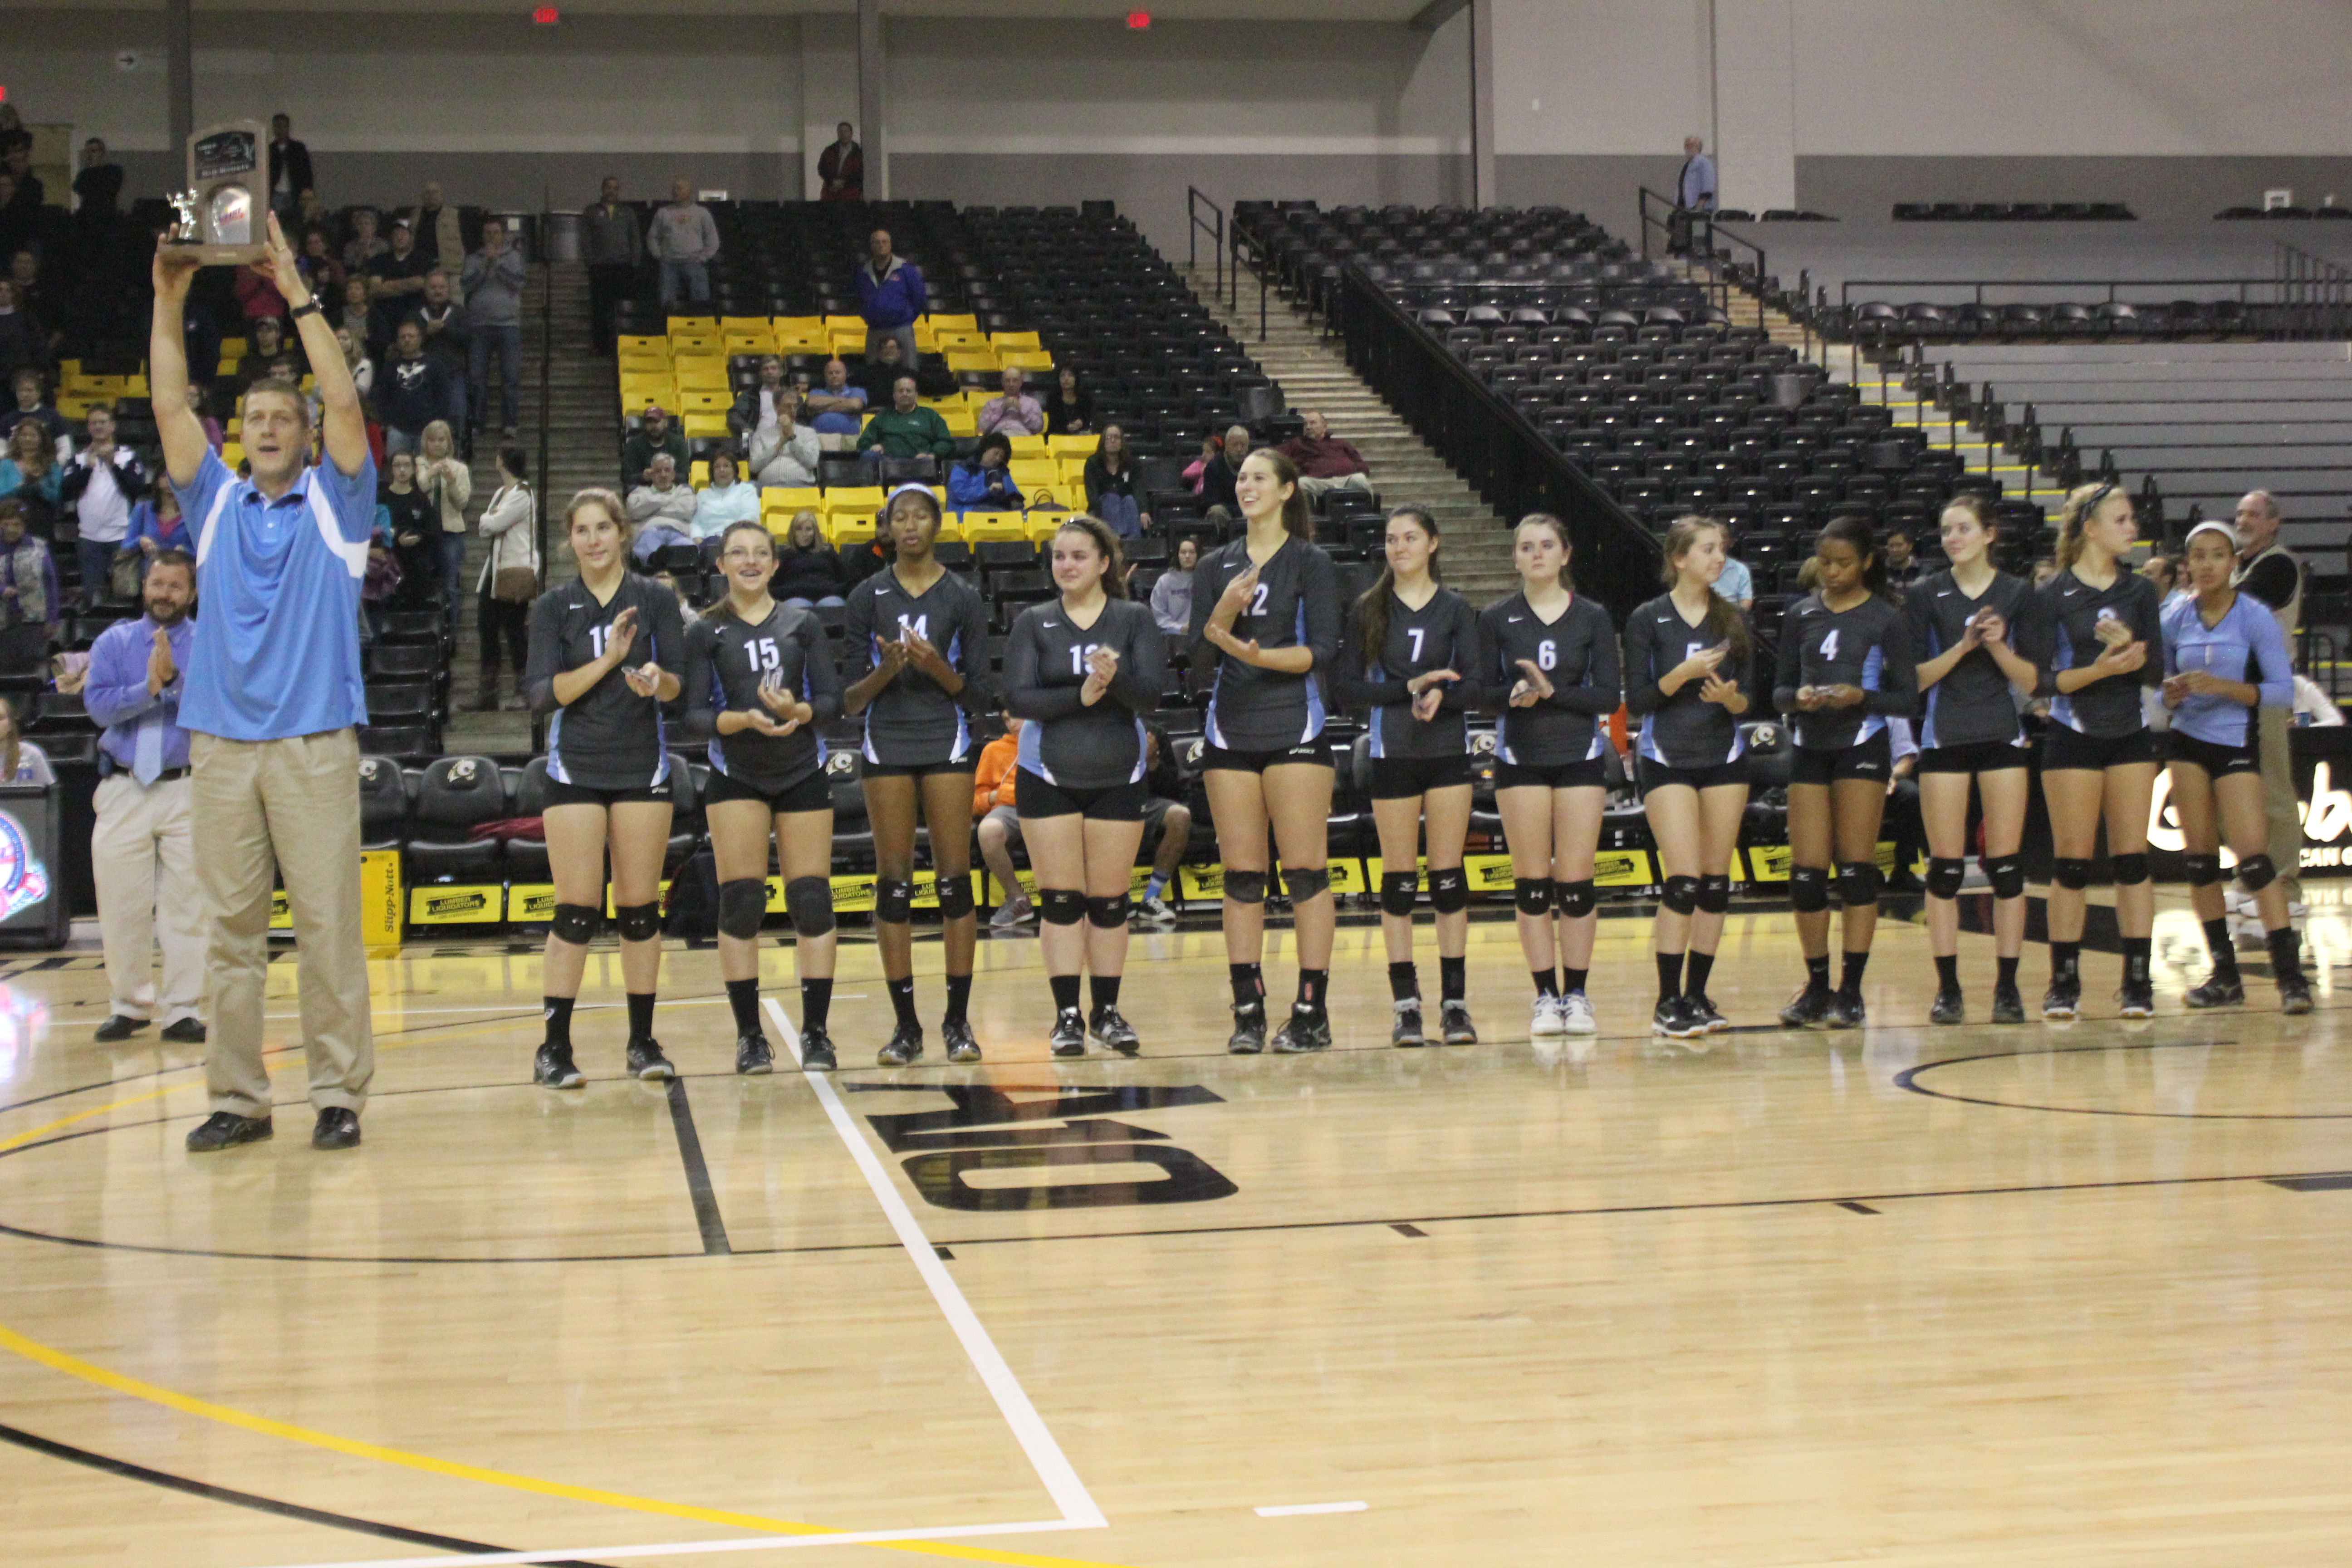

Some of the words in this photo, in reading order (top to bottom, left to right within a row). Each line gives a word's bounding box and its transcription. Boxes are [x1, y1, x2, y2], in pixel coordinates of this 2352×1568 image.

[1241, 583, 1269, 616] 2
[744, 637, 779, 671] 15
[1407, 628, 1424, 662] 7
[1538, 639, 1556, 671] 6
[1819, 629, 1840, 660] 4
[431, 900, 481, 912] LIQUIDATORS
[440, 896, 471, 905] LUMBER
